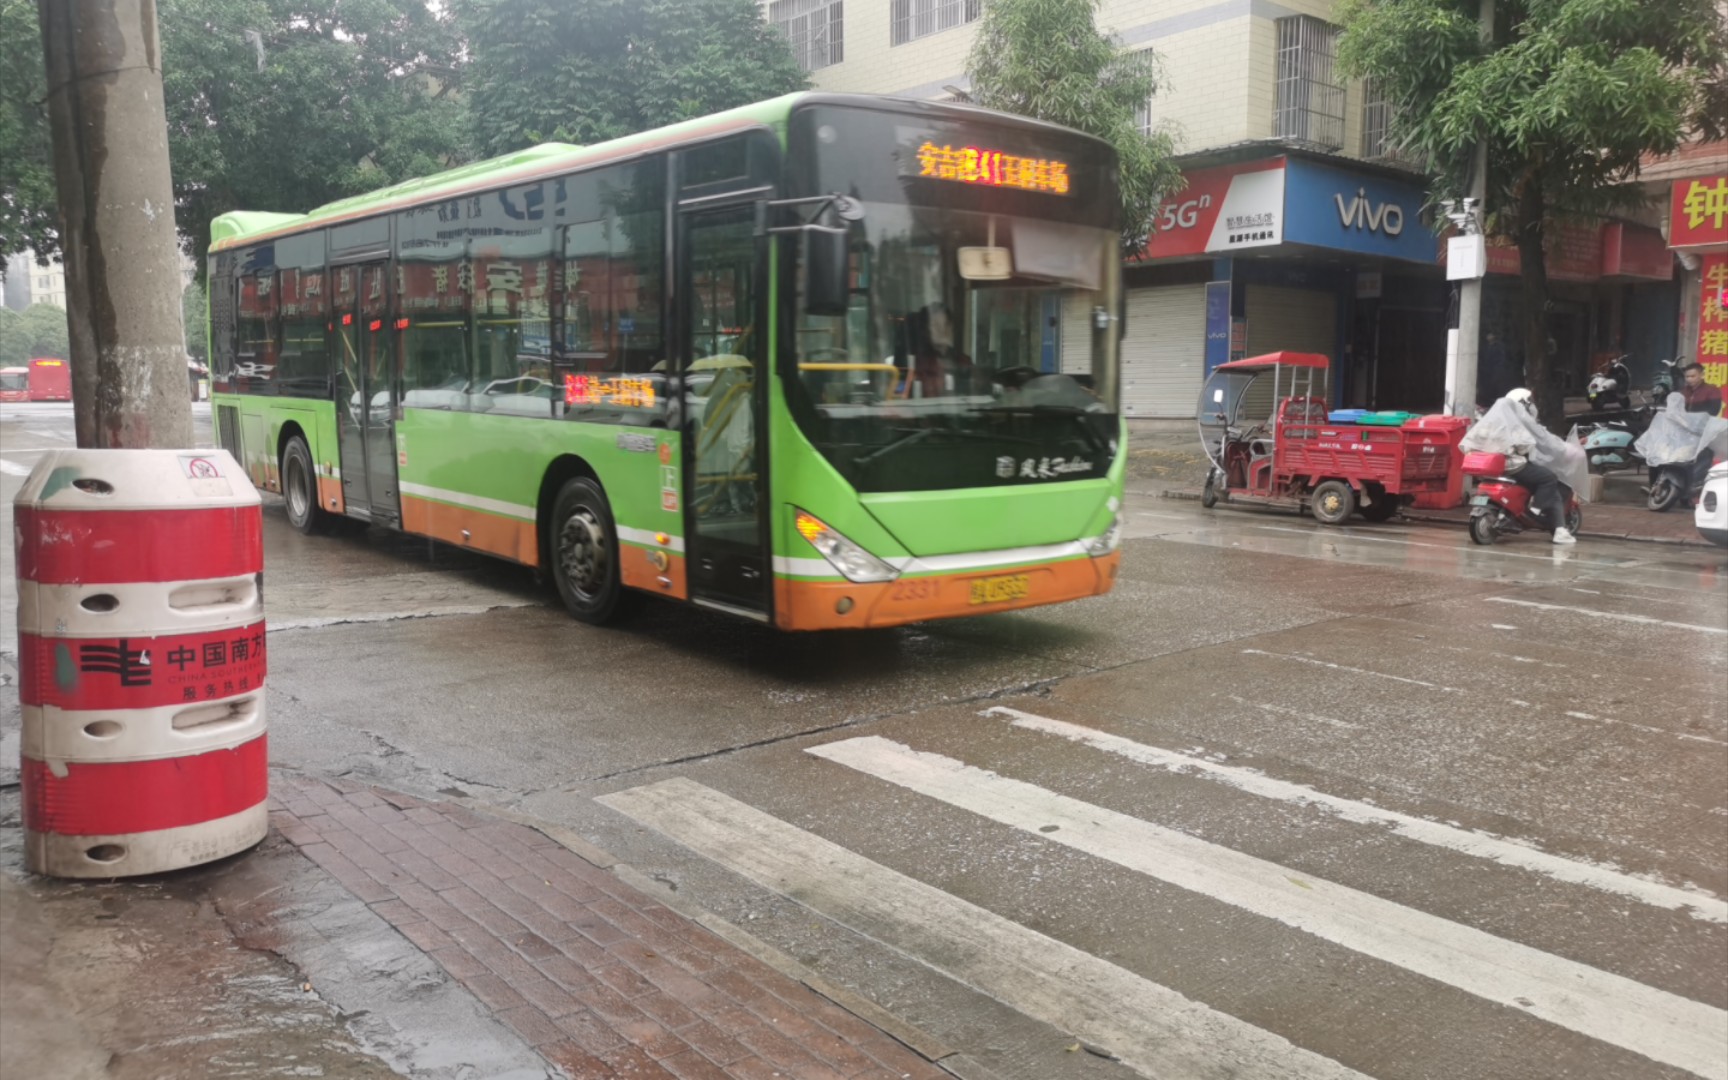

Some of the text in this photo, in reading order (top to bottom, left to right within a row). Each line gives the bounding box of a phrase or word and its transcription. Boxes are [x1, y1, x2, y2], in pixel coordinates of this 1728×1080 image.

[1334, 187, 1404, 237] vivo
[1682, 177, 1728, 230] 钟
[167, 631, 266, 672] 中国南方
